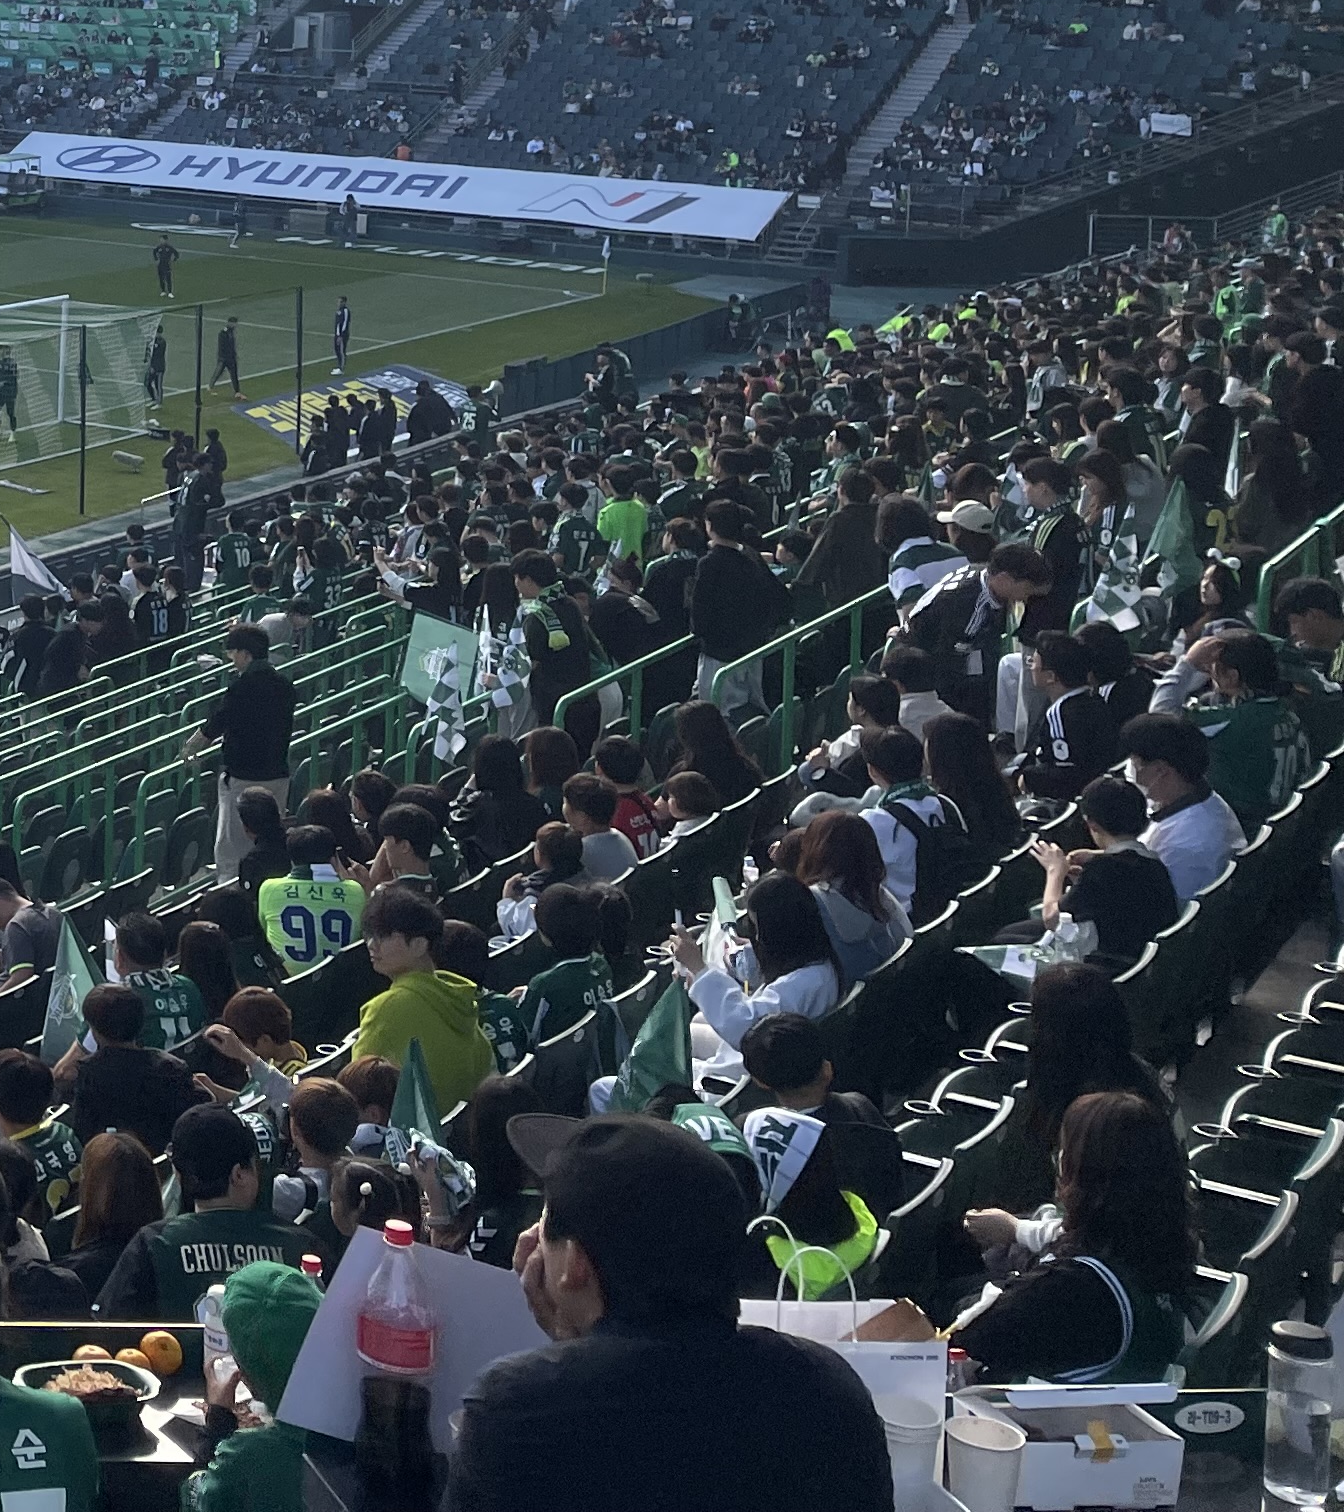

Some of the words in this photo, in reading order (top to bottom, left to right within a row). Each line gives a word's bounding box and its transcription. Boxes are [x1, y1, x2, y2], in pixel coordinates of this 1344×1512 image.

[167, 153, 470, 199] HYUNDAI
[462, 412, 477, 431] 25
[235, 548, 250, 568] 10
[151, 609, 168, 635] 18
[283, 885, 347, 903] 김신욱
[280, 904, 353, 964] 99
[180, 1243, 286, 1275] CHULSOON
